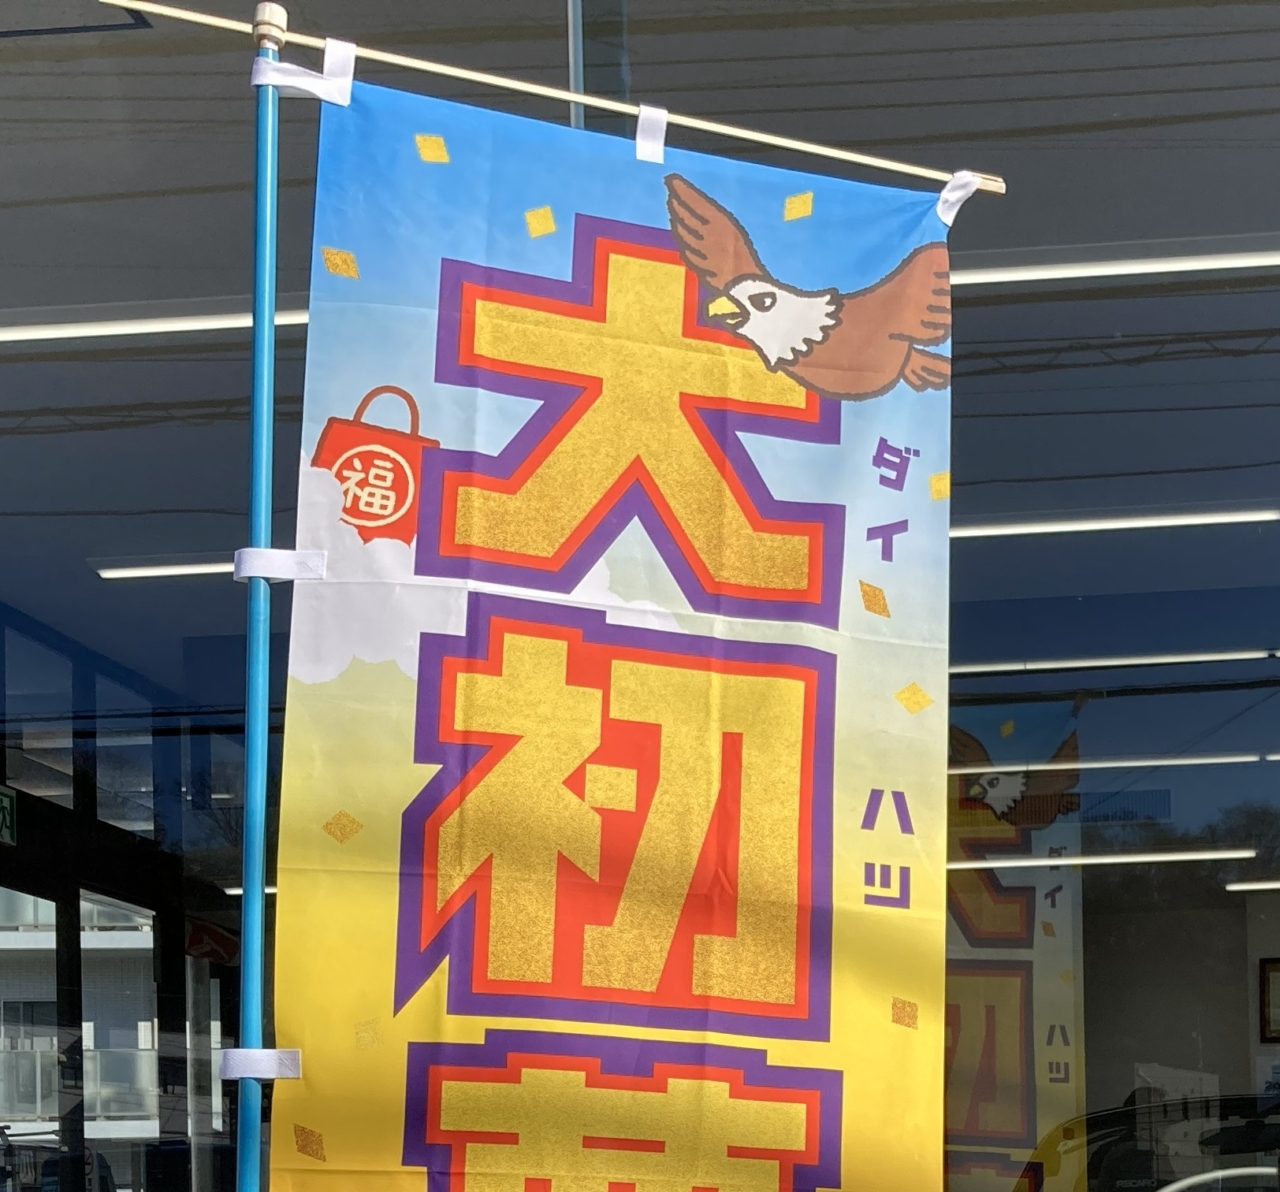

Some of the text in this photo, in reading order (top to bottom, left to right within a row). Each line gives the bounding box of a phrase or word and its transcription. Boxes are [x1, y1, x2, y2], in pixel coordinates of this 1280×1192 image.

[341, 457, 397, 516] 福
[860, 436, 920, 909] ダイ ハツ
[1115, 1178, 1158, 1189] RECARO
